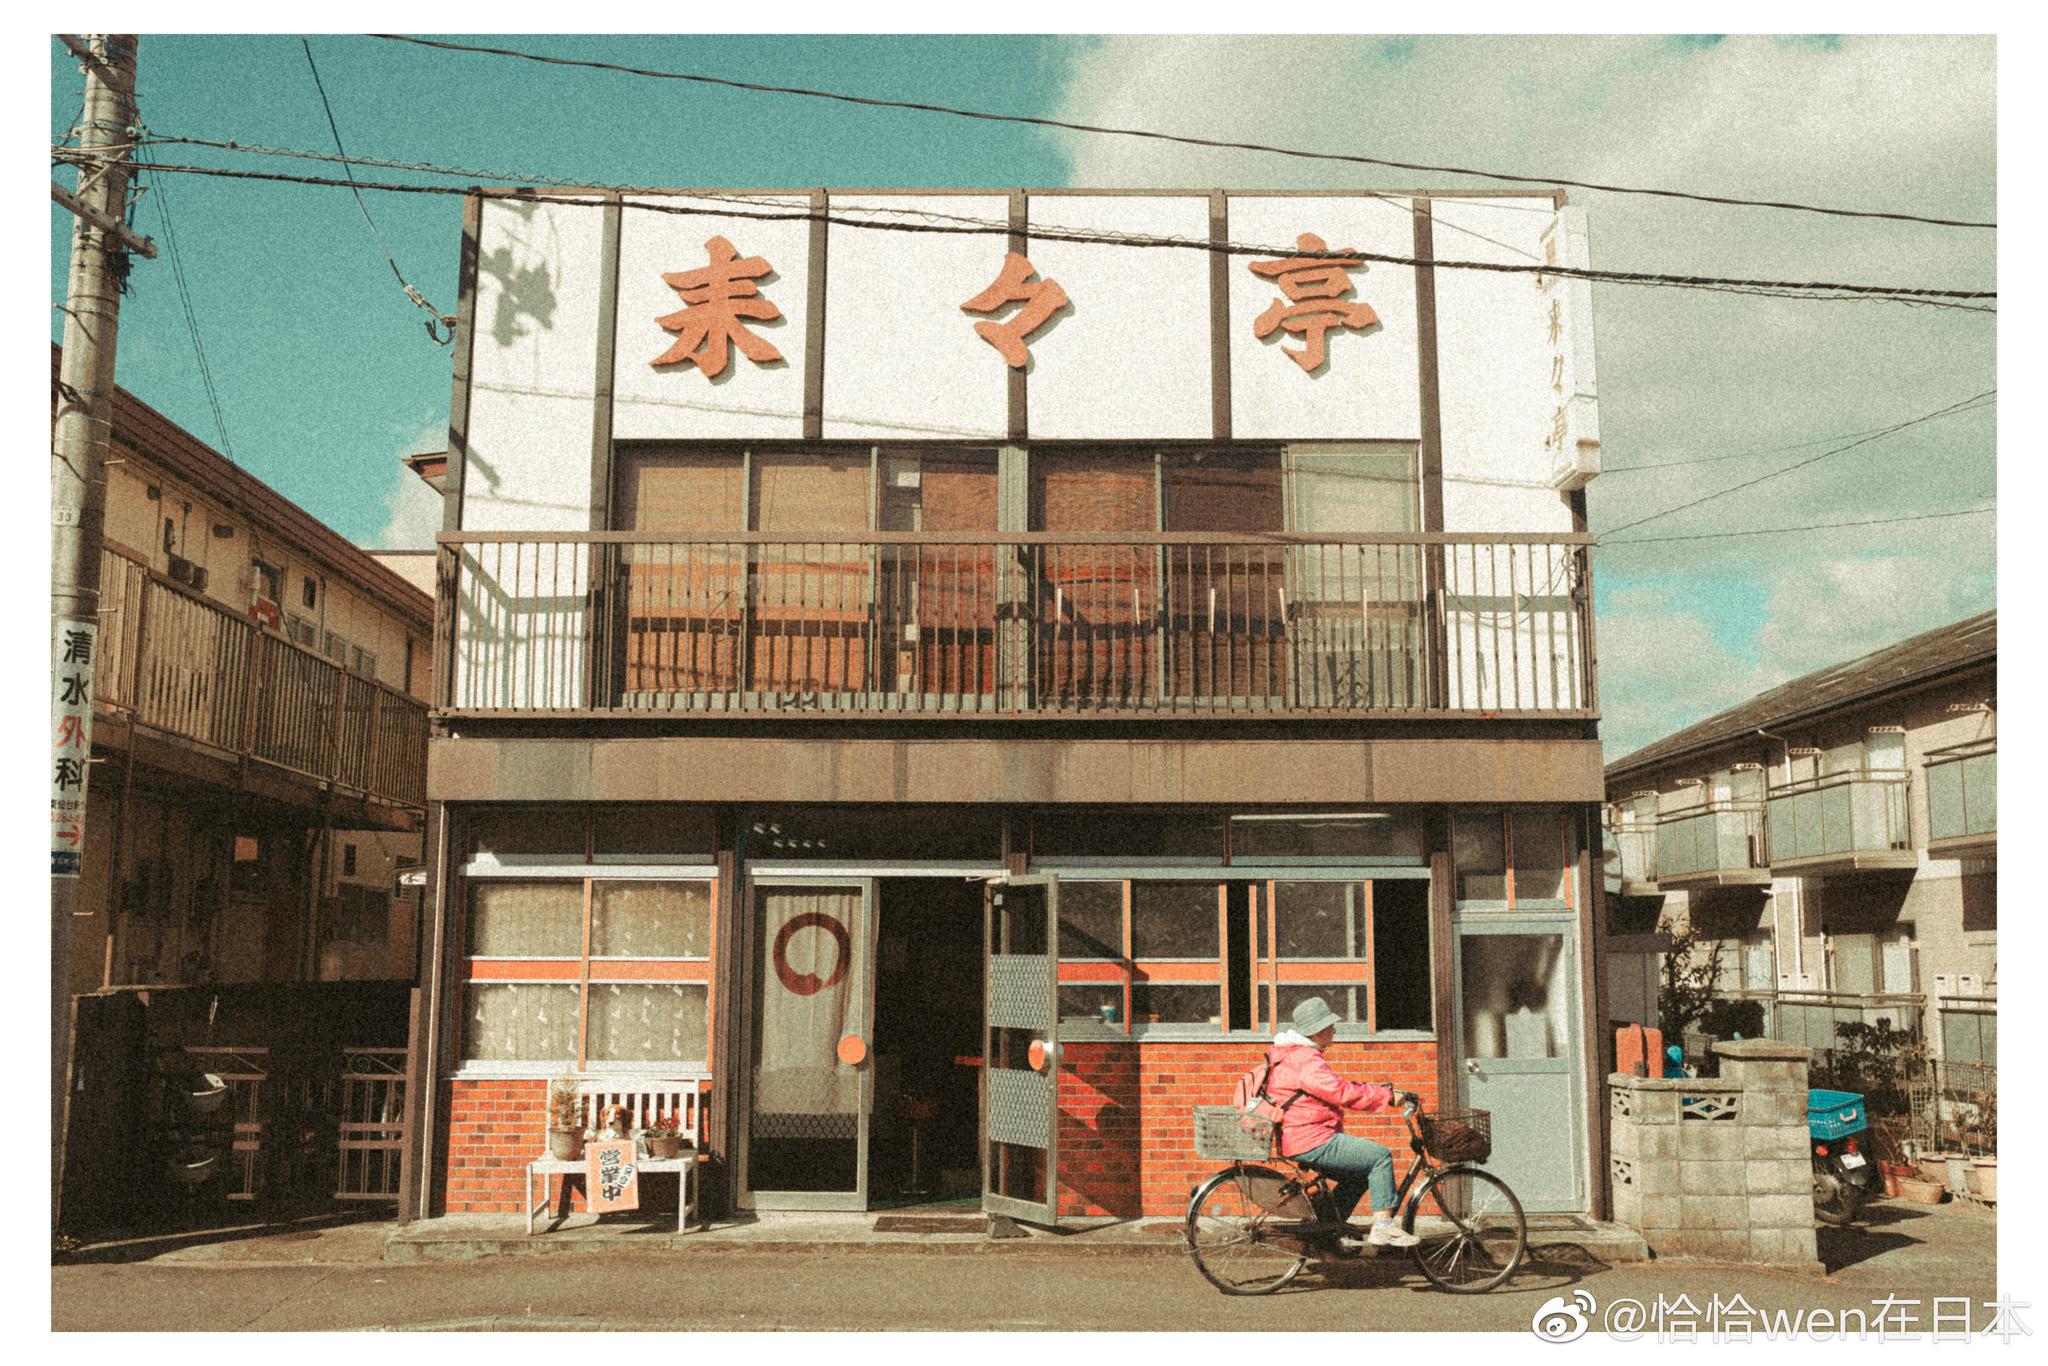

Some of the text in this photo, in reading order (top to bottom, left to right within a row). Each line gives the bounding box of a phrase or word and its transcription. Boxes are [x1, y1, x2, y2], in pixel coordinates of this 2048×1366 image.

[54, 629, 92, 792] 清水外科
[600, 1149, 622, 1201] 営業中
